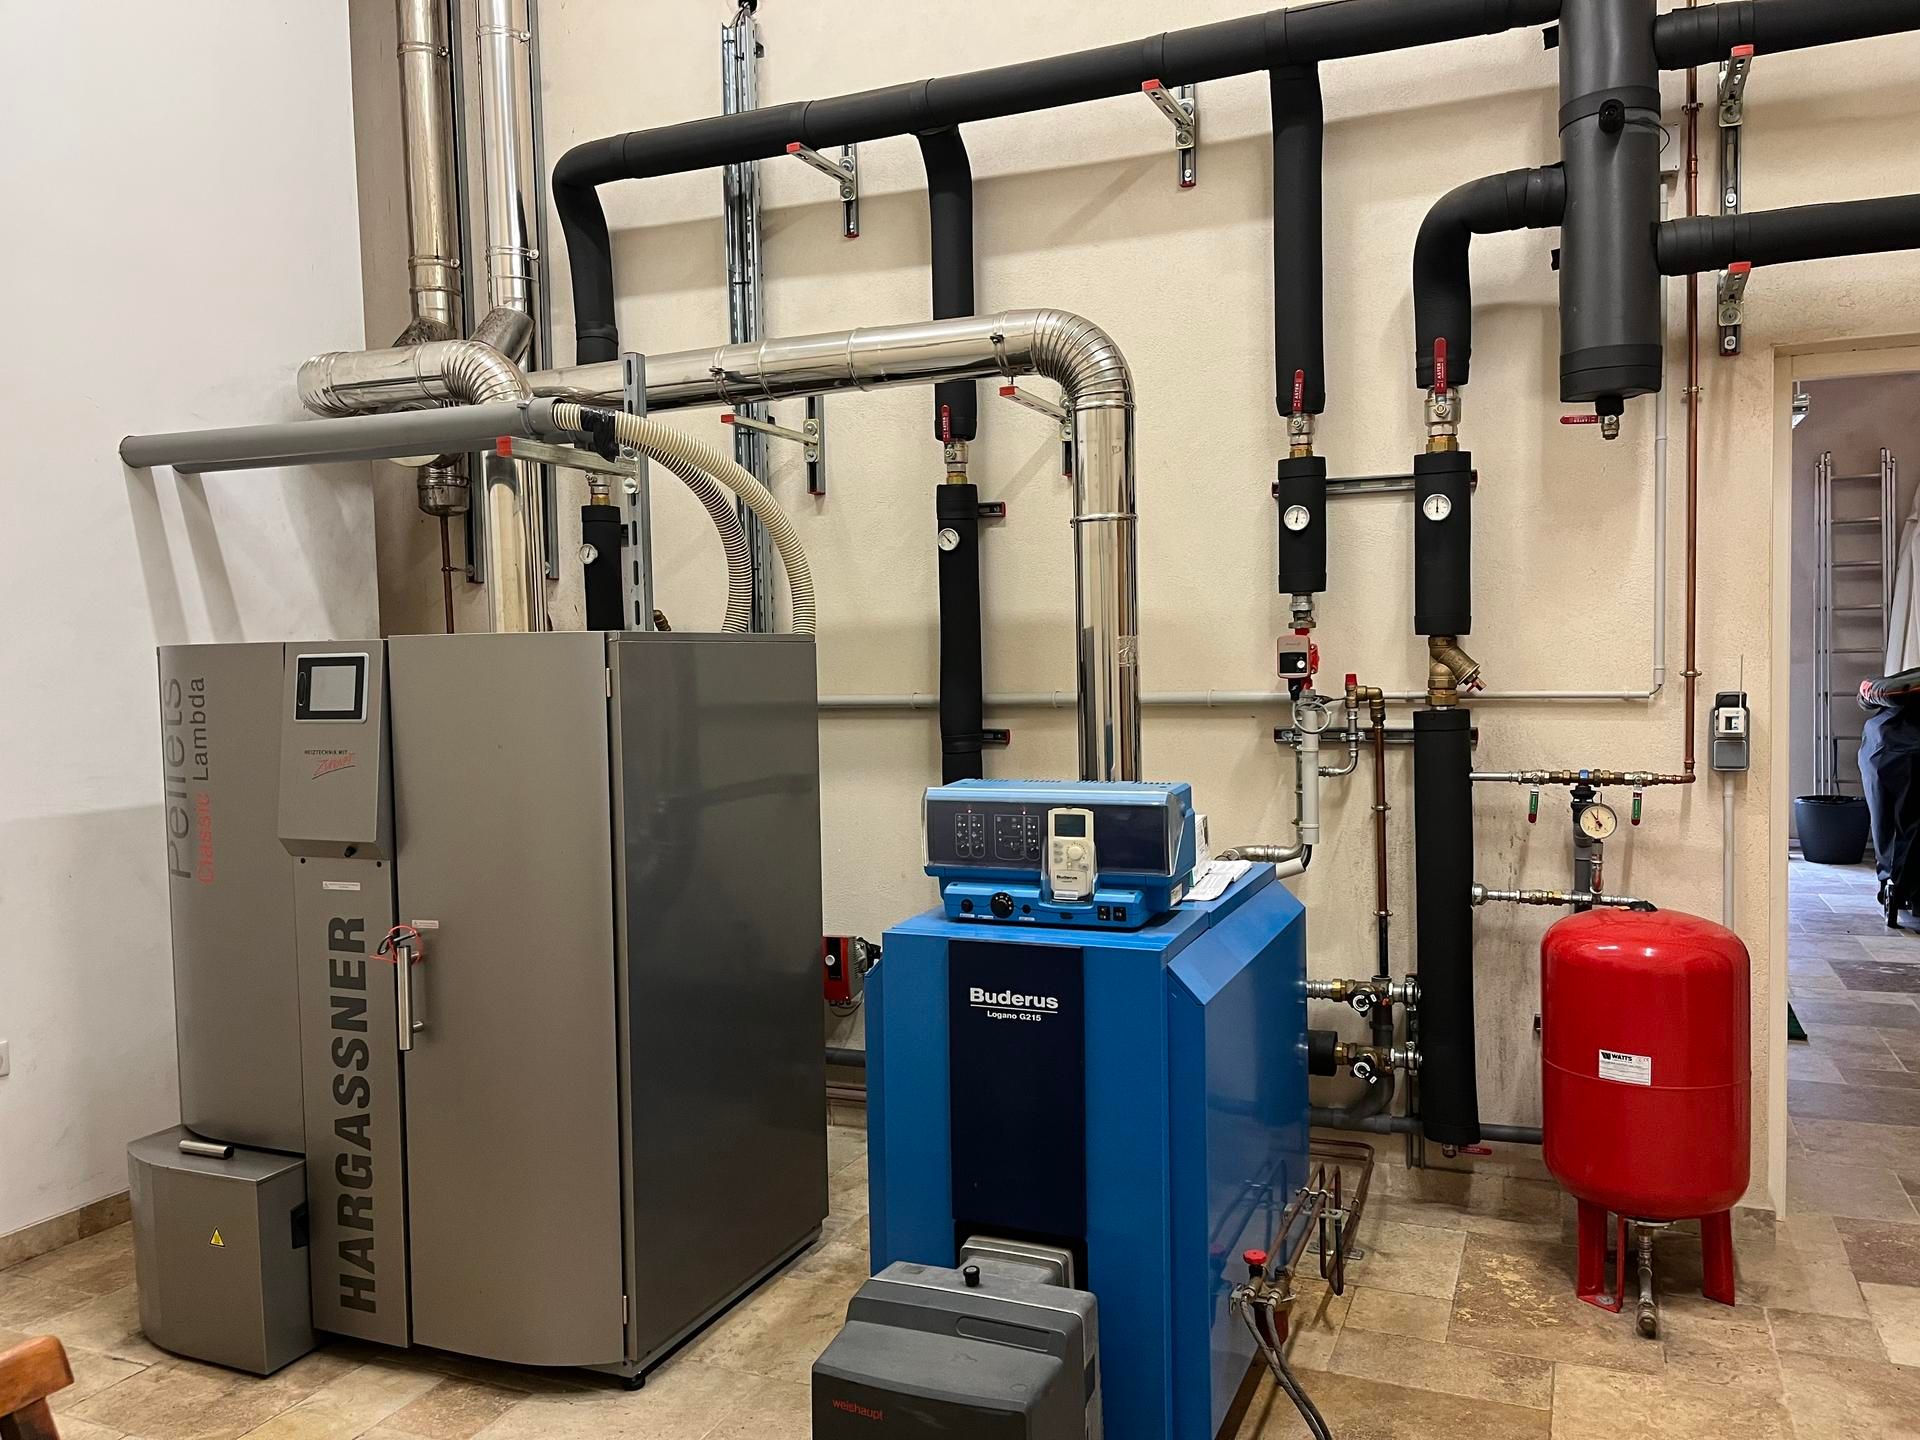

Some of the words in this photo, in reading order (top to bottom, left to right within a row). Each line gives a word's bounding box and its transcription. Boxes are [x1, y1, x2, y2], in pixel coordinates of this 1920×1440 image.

[189, 677, 209, 781] Lambda
[164, 677, 192, 879] Pellets
[969, 987, 1059, 1009] Buderus
[987, 1010, 1018, 1020] Logano
[1019, 1013, 1042, 1022] G215
[1611, 1053, 1633, 1062] WATTS
[327, 915, 377, 1314] HARGASSNER
[831, 1398, 884, 1421] weishaupt
